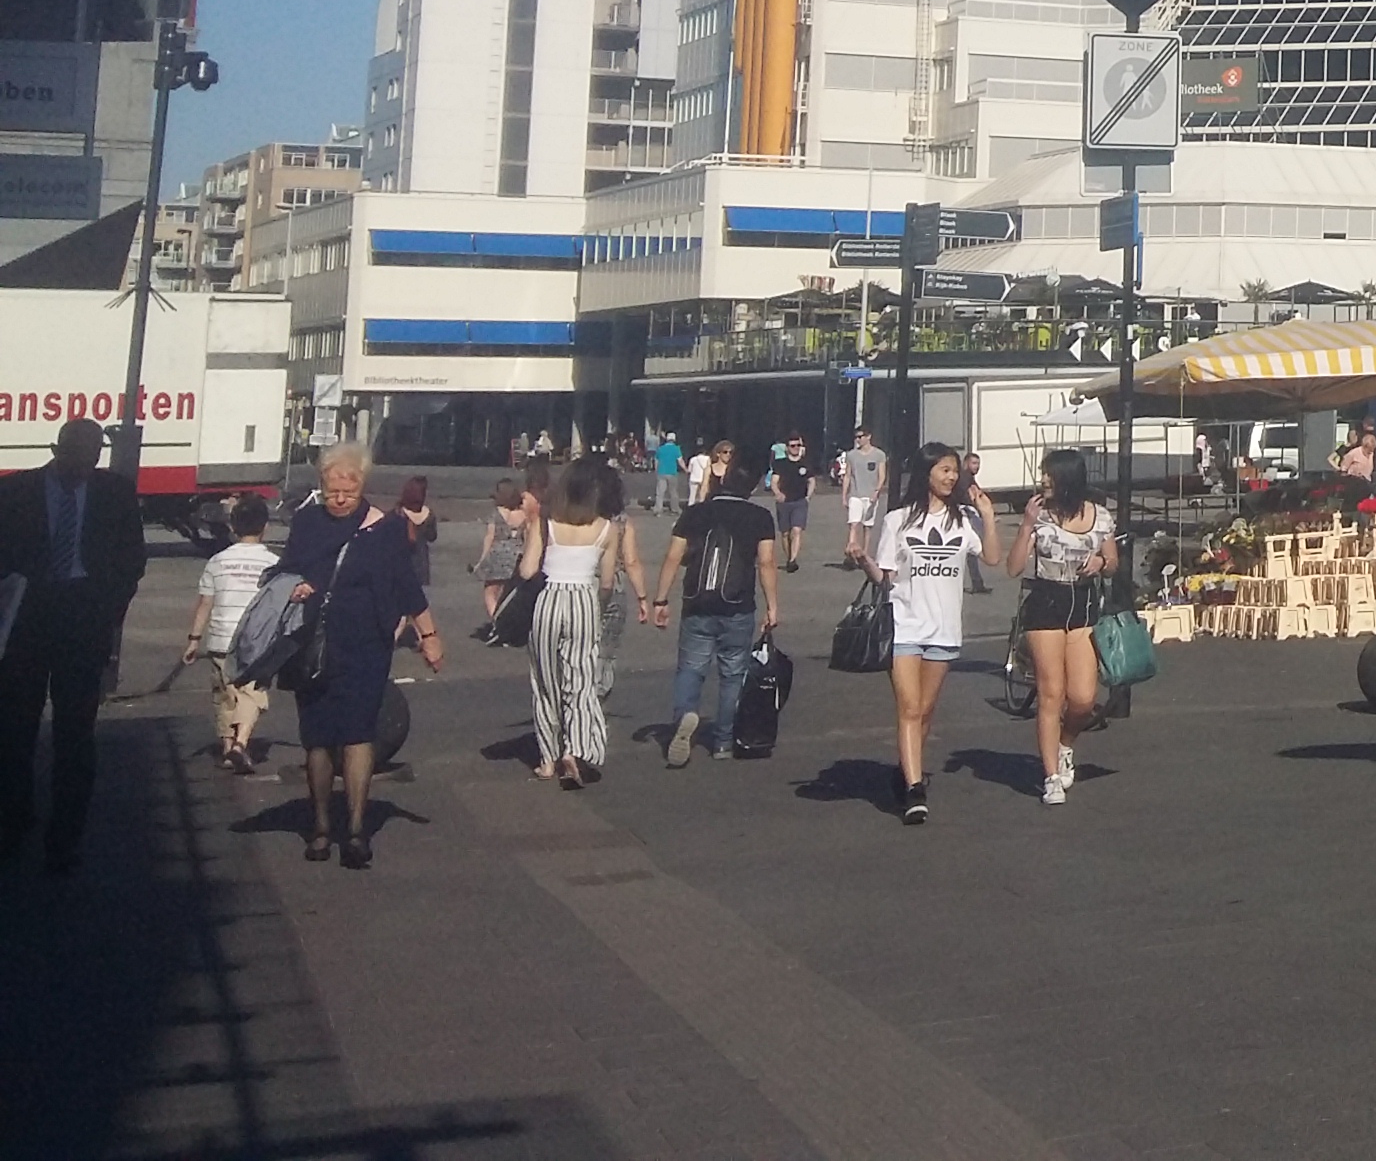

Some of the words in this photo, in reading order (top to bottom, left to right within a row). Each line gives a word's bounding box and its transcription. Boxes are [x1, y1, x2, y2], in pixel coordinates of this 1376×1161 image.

[1118, 41, 1153, 52] ZONE
[364, 376, 449, 385] Bibliotheektheater
[911, 563, 959, 577] adidas
